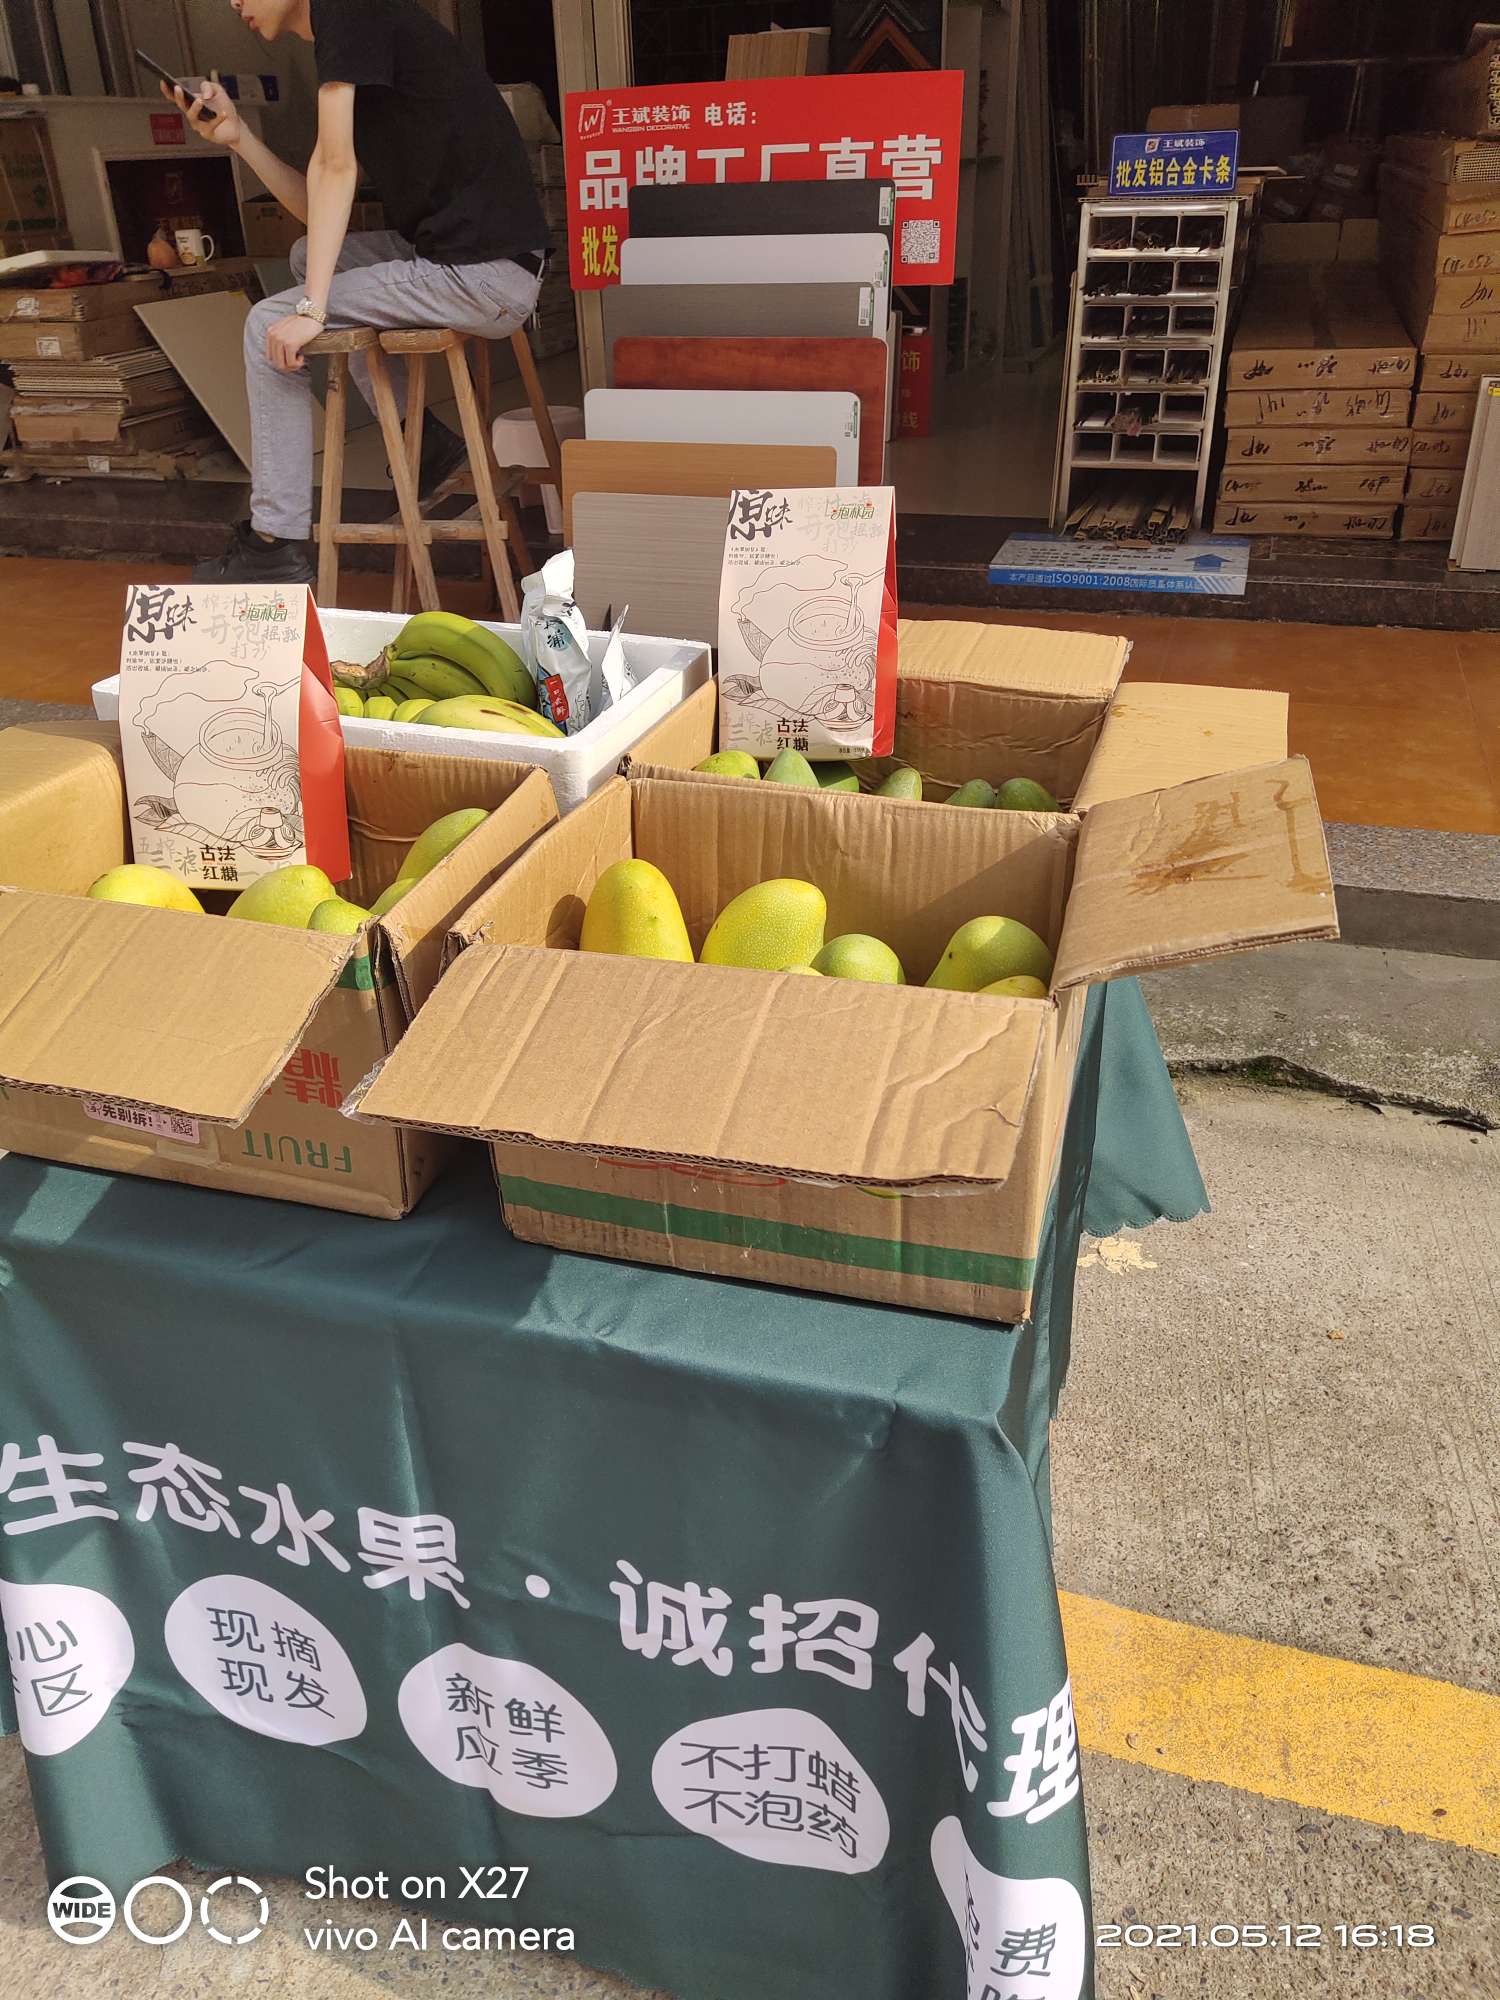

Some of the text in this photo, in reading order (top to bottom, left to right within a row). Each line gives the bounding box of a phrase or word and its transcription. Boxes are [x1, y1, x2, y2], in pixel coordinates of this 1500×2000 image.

[612, 104, 691, 126] 王斌装饰
[1115, 154, 1232, 188] 批发铝合金卡条
[580, 224, 620, 277] 批发
[776, 718, 809, 734] 古法
[776, 736, 809, 752] 红糖
[199, 844, 236, 863] 古法
[202, 864, 239, 883] 红糖
[241, 1128, 352, 1174] FRUIT
[206, 1605, 322, 1673] 现摘
[218, 1655, 336, 1719] 现发
[445, 1672, 566, 1743] 新鲜
[455, 1725, 569, 1790] 应季
[680, 1742, 863, 1815] 不打蜡
[681, 1785, 859, 1860] 不泡药
